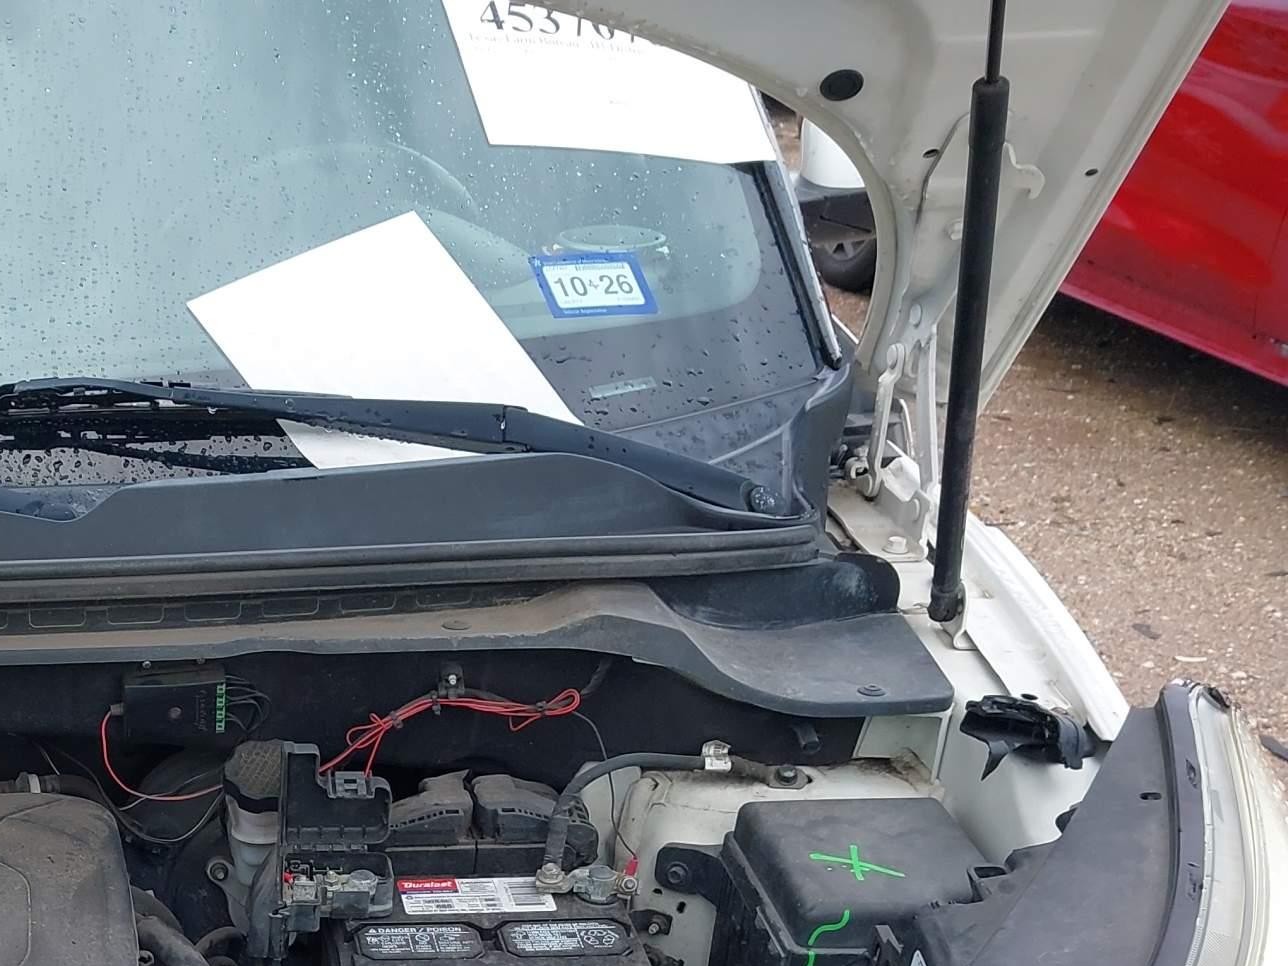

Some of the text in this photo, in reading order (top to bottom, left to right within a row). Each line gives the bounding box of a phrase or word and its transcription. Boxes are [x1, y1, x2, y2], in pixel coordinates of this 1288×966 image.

[553, 274, 635, 297] 10 26
[401, 880, 453, 889] Duralast
